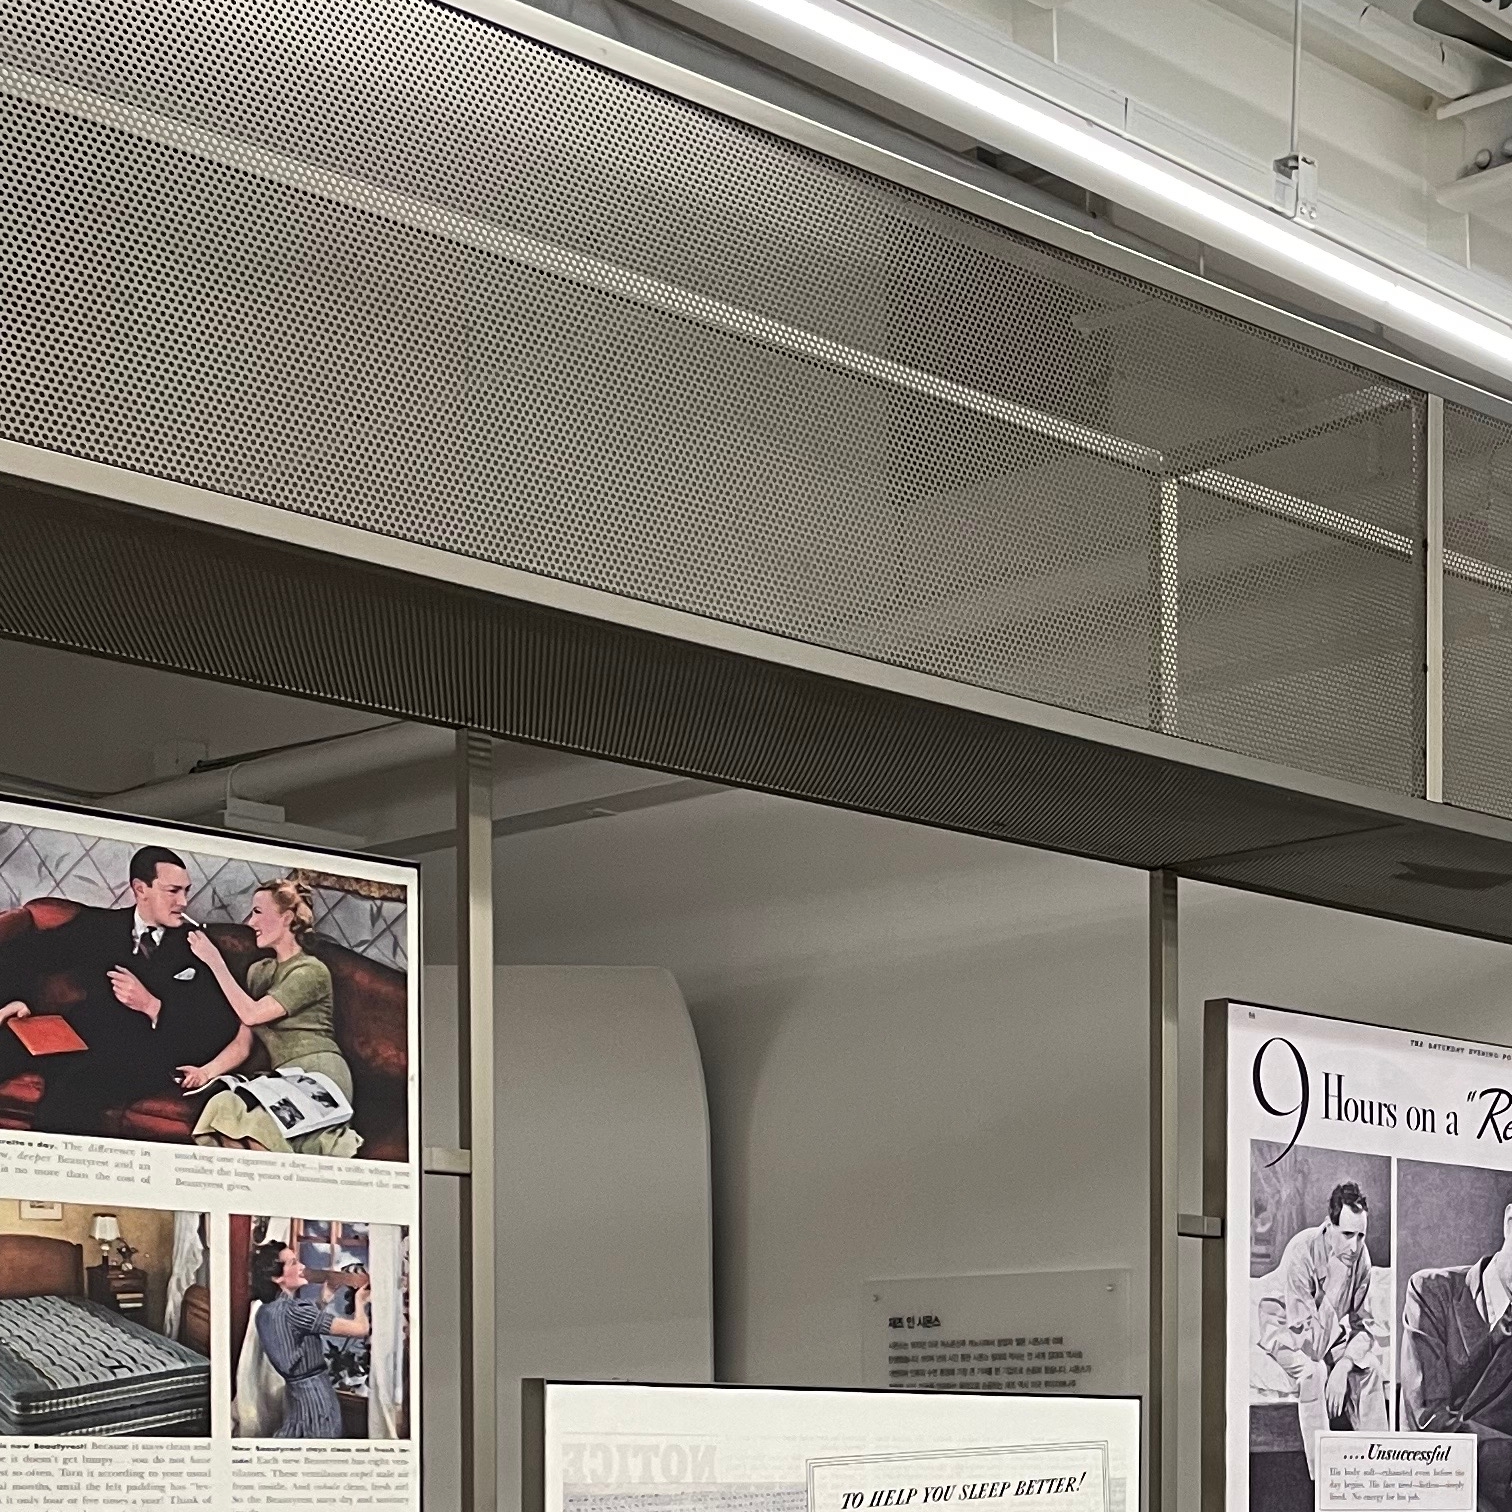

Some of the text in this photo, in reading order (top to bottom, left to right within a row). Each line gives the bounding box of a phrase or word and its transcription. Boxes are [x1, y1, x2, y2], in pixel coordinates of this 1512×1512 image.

[1253, 1037, 1309, 1168] 9
[1321, 1071, 1397, 1128] Hours
[1406, 1106, 1436, 1134] on
[1446, 1113, 1459, 1136] a
[841, 1470, 1087, 1509] TO HELP YOU SLEEP BETTER!
